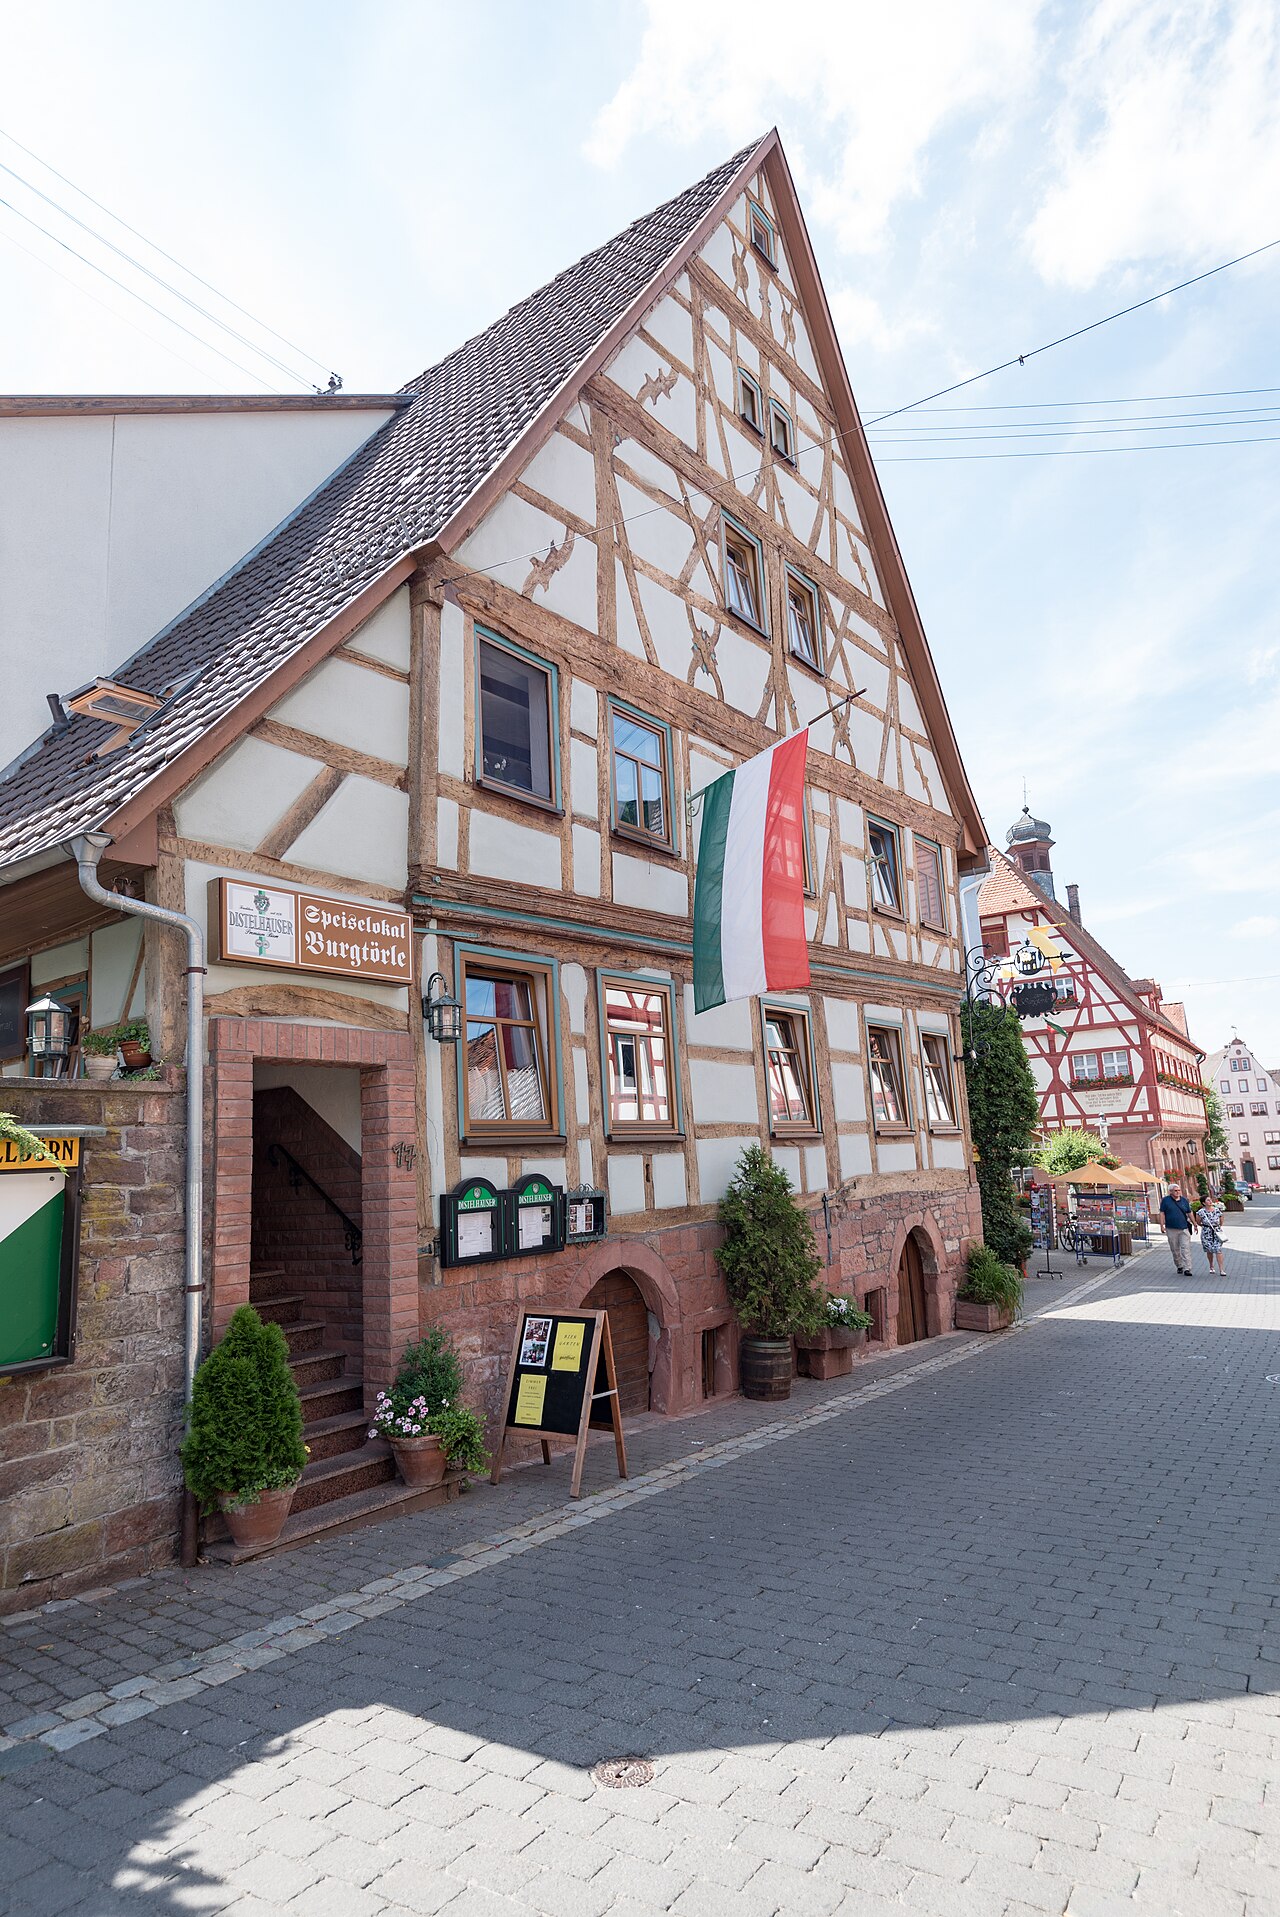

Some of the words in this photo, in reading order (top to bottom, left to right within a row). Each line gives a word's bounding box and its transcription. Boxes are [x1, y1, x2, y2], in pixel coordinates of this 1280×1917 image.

[304, 905, 406, 939] Speiselokal
[304, 930, 406, 968] Burgtörle
[391, 1141, 417, 1171] 17
